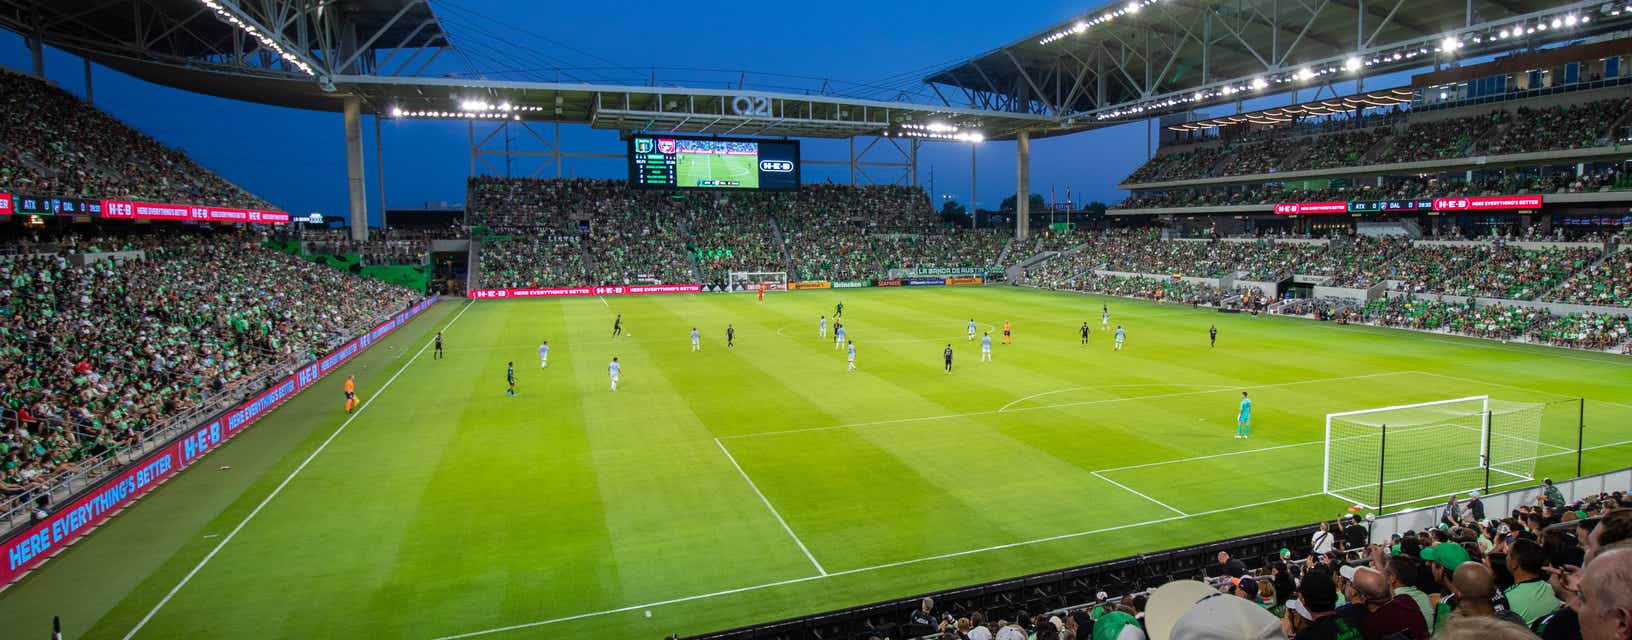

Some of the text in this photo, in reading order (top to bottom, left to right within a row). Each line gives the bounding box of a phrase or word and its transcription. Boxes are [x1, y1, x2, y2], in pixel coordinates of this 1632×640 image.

[732, 96, 768, 116] Q2
[24, 199, 36, 209] ATX
[63, 202, 74, 212] DAL
[834, 280, 862, 288] Heineken
[228, 409, 245, 431] HERE
[9, 454, 172, 571] HERE EVERYTHING'S BETTER
